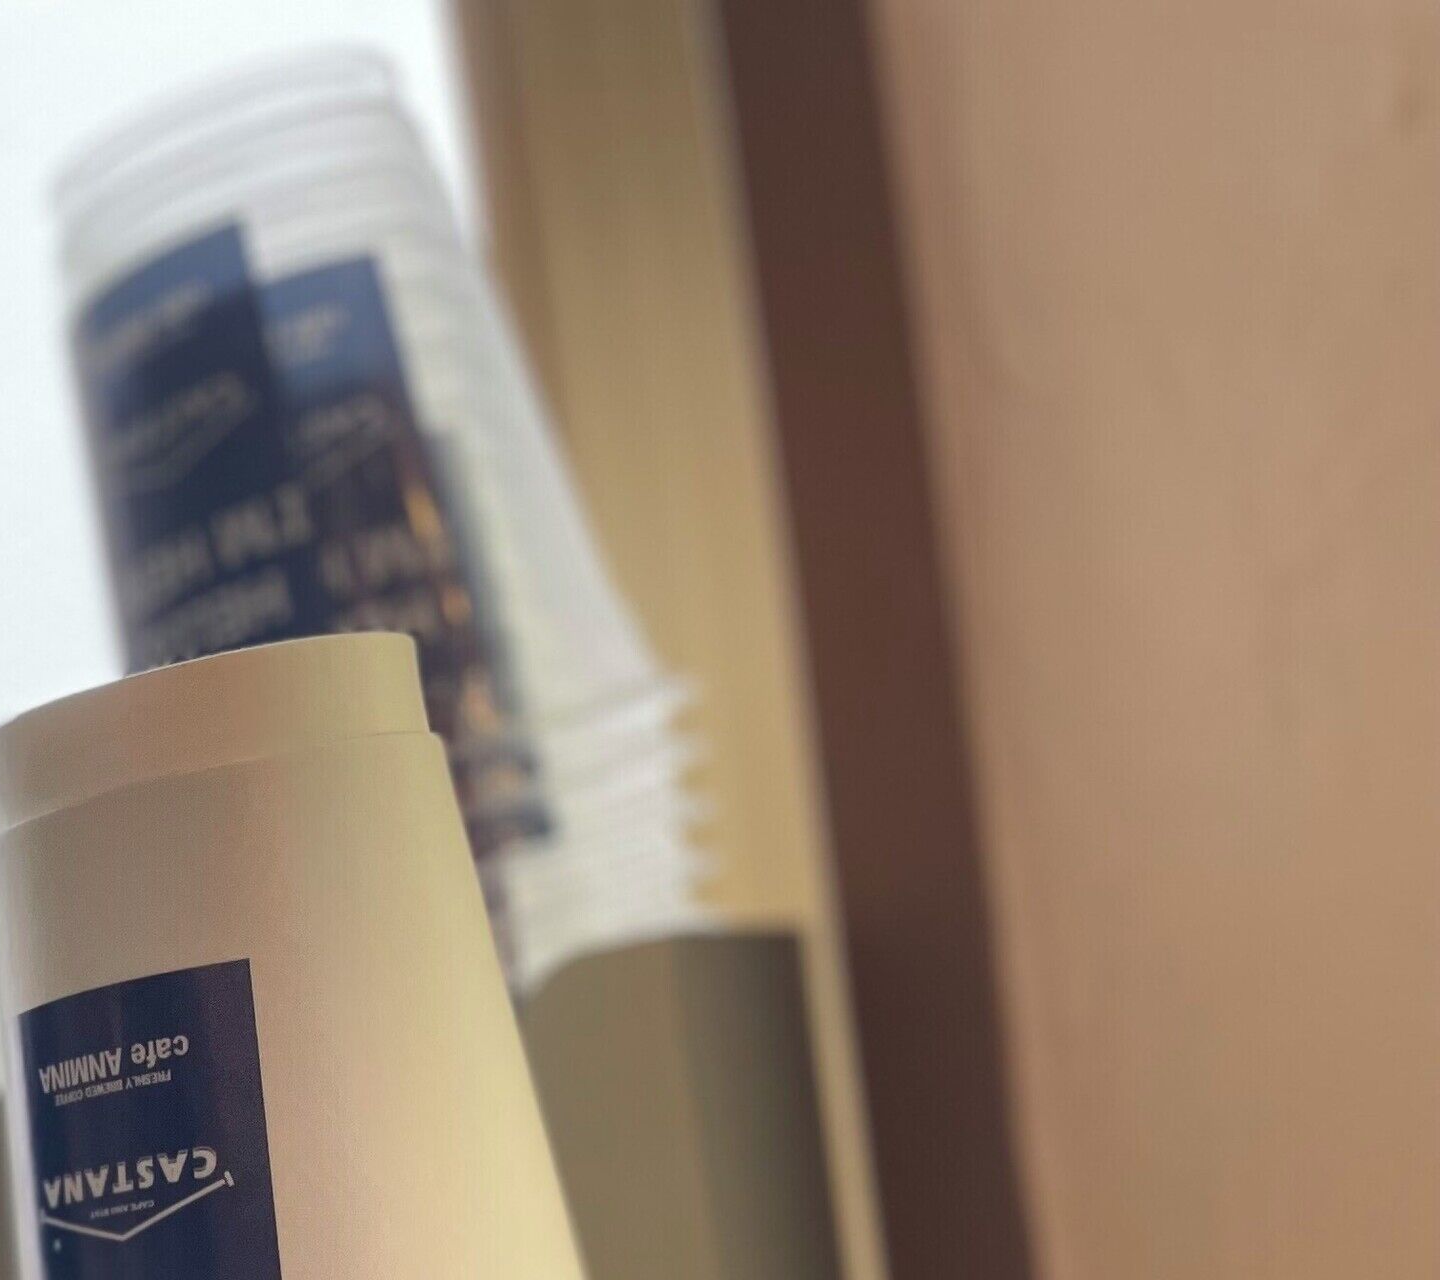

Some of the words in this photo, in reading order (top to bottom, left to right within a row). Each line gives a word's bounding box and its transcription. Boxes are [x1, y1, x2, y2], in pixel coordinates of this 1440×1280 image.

[131, 1035, 189, 1067] cafe
[39, 1047, 121, 1093] ANMINA
[125, 1069, 171, 1088] FRESHLY
[54, 1089, 83, 1106] COFFEE
[85, 1078, 123, 1098] BREWED
[42, 1146, 217, 1208] CASTANA
